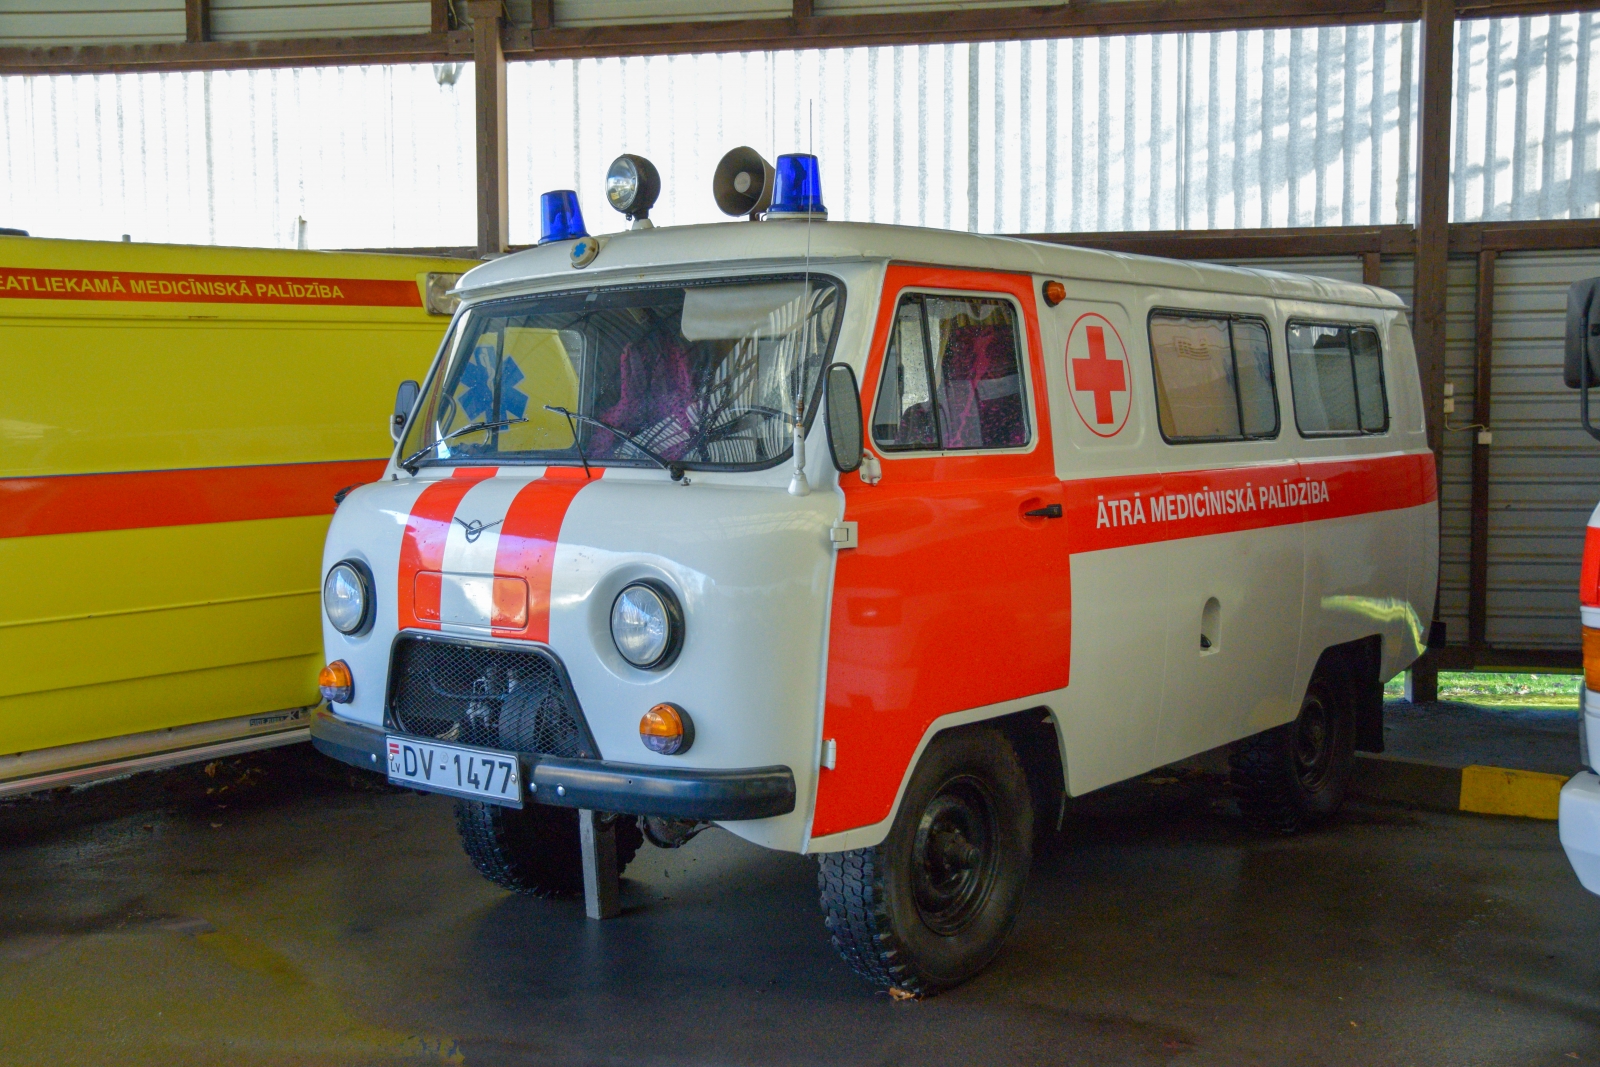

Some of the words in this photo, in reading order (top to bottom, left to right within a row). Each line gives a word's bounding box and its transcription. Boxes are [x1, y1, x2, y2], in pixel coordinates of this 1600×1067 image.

[130, 279, 252, 296] MEDICĪNISKĀ
[256, 282, 344, 299] PALĪDZĪBA
[1096, 492, 1146, 528] ĀTRĀ
[1150, 482, 1256, 522] MEDICĪNISKĀ
[1259, 477, 1329, 510] PALĪDZĪBA
[390, 761, 400, 773] LV
[403, 745, 512, 793] DV-1477
